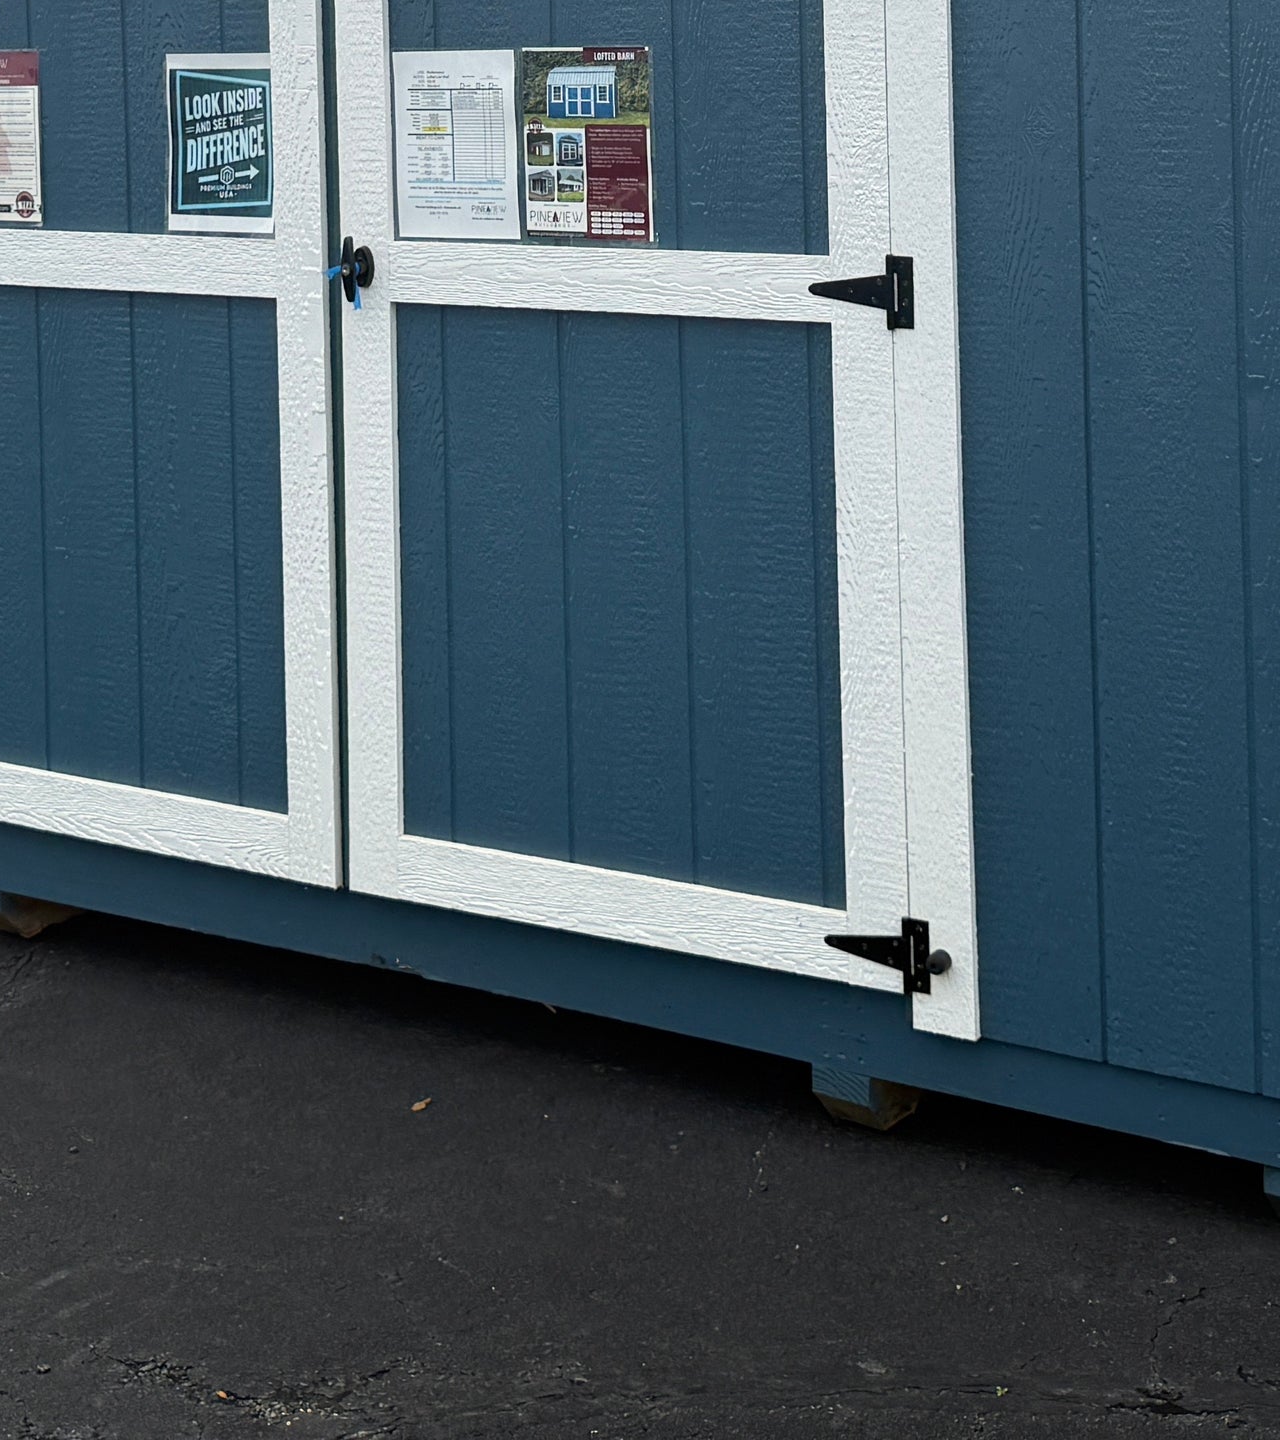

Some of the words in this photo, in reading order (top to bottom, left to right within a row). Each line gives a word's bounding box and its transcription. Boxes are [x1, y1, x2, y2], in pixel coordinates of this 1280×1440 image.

[593, 51, 616, 61] LOFTED
[616, 51, 635, 61] BARN
[184, 91, 222, 121] LOOK
[222, 87, 263, 115] INSIDE
[195, 119, 212, 134] AND
[212, 117, 228, 131] SEE
[228, 114, 244, 128] THE
[200, 184, 225, 192] PREMIUM
[219, 191, 234, 199] USA
